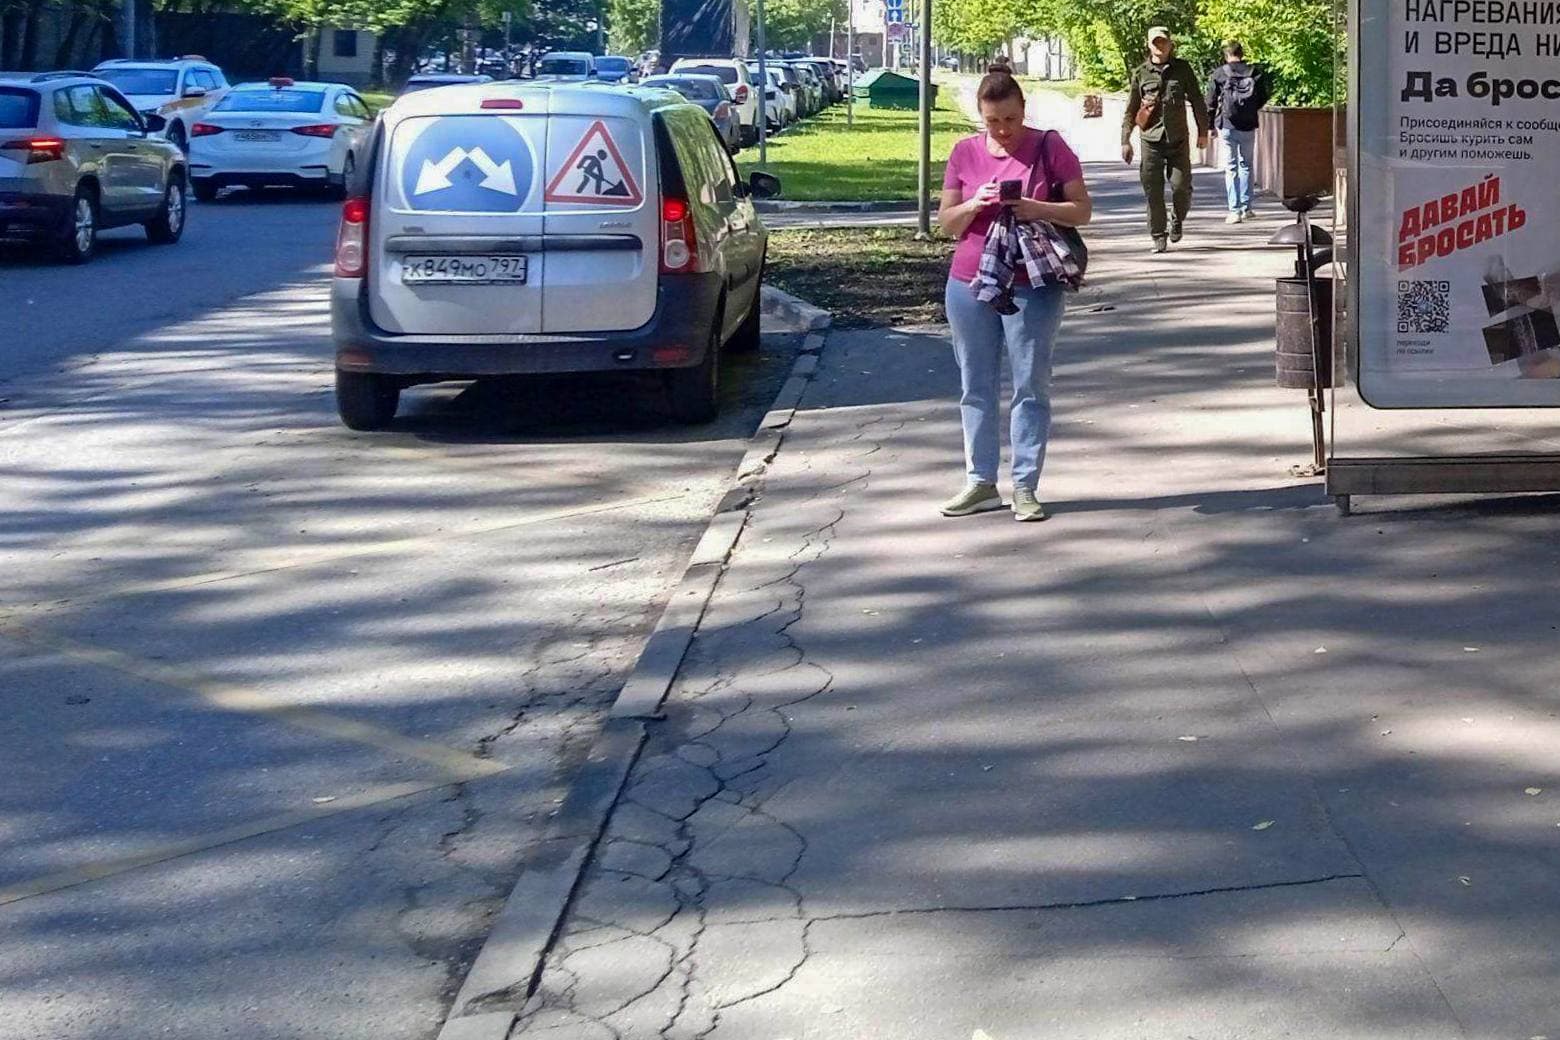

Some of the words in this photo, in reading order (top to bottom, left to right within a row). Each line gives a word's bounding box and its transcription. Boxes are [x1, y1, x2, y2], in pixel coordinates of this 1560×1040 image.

[1404, 30, 1420, 53] И
[1435, 31, 1521, 59] ВРЕДА
[1401, 70, 1459, 103] Да
[1400, 115, 1502, 132] Присоединяйся
[1506, 120, 1514, 129] к
[1400, 131, 1458, 147] Бросишь
[1461, 134, 1505, 147] курить
[1508, 135, 1533, 145] сам
[1400, 148, 1408, 158] и
[1411, 148, 1458, 161] другим
[1461, 148, 1534, 160] поможешь.
[1398, 173, 1500, 244] ДАВАЙ
[1398, 203, 1527, 273] БРОСАТЬ
[490, 257, 520, 273] 797
